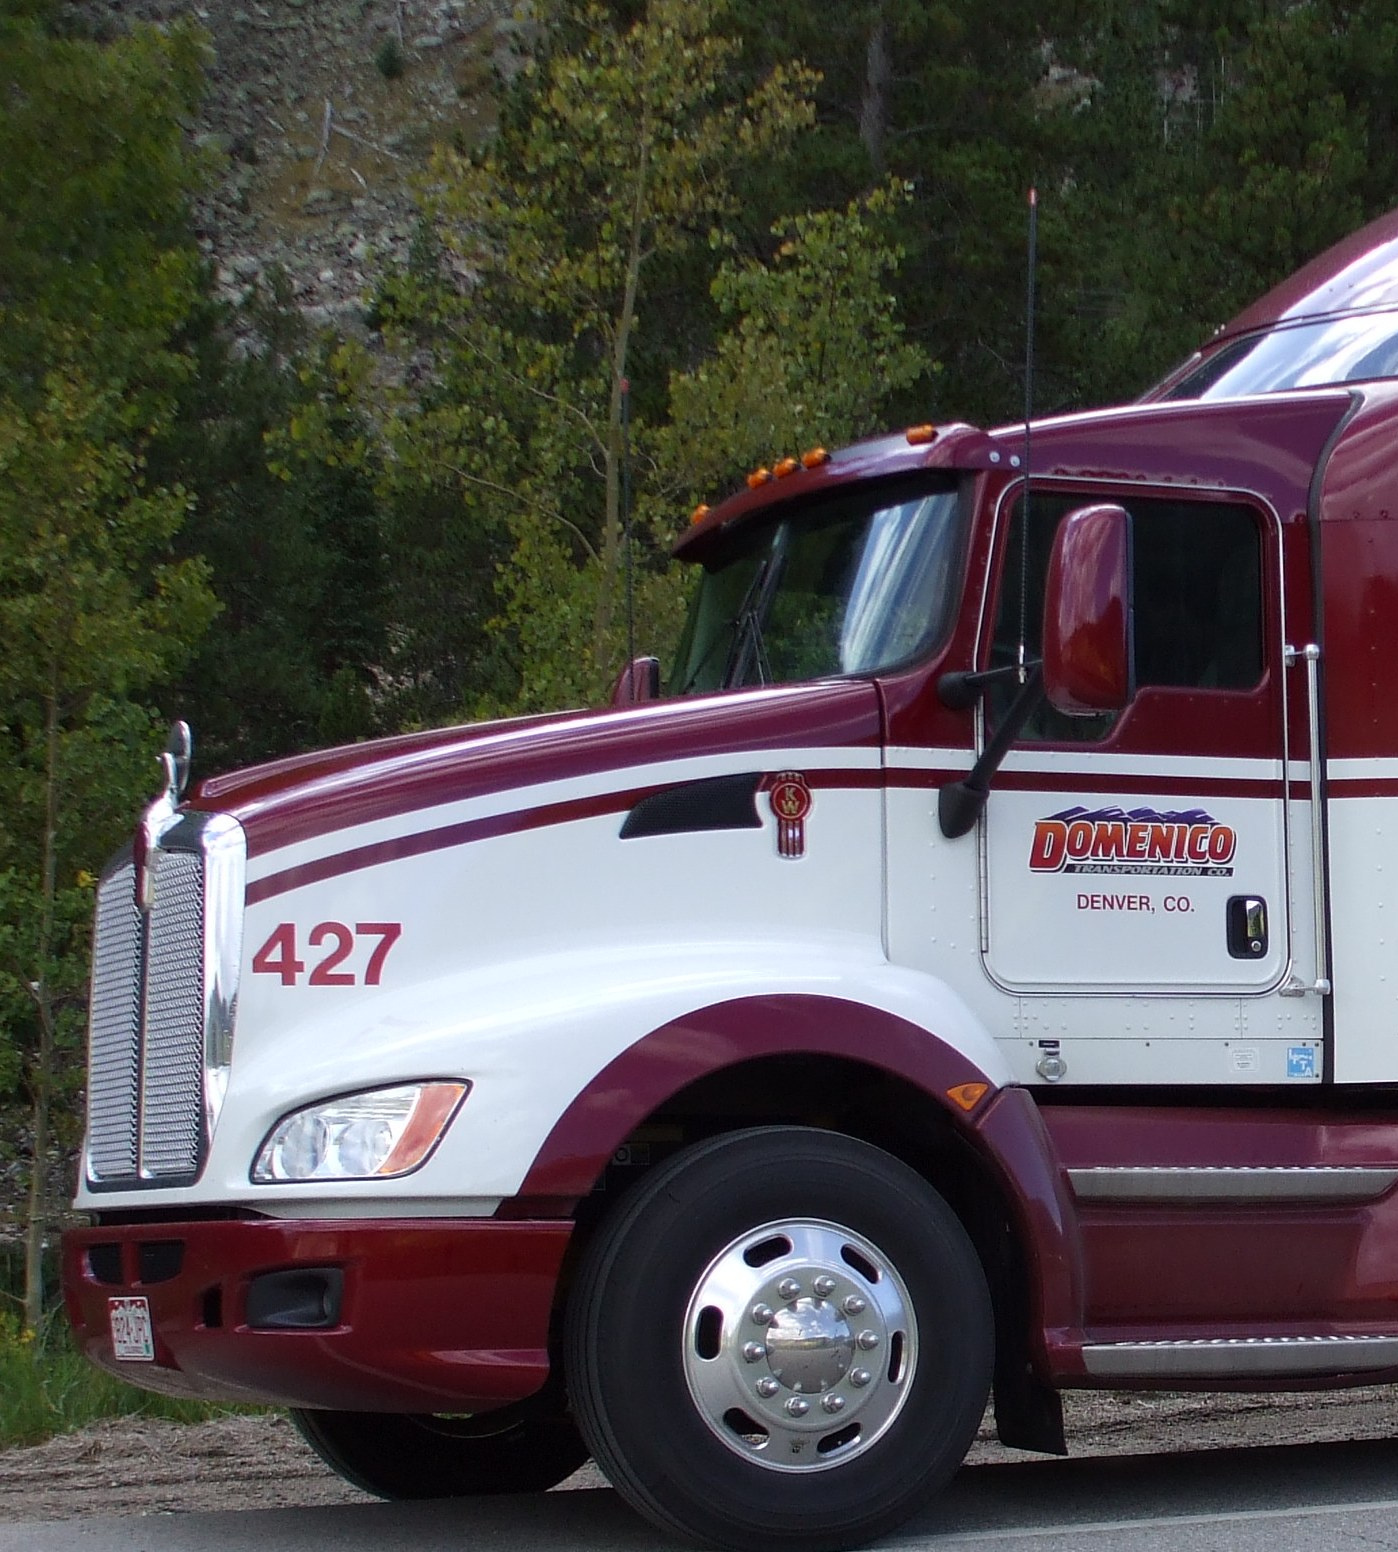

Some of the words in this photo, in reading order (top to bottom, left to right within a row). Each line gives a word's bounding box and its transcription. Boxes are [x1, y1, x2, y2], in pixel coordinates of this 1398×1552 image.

[1029, 821, 1237, 873] DOMENICO
[1074, 864, 1201, 875] TRANSPORTATION
[1207, 868, 1230, 877] CO.
[1077, 894, 1155, 914] DENVER,
[1163, 896, 1195, 912] CO.
[252, 921, 402, 986] 427
